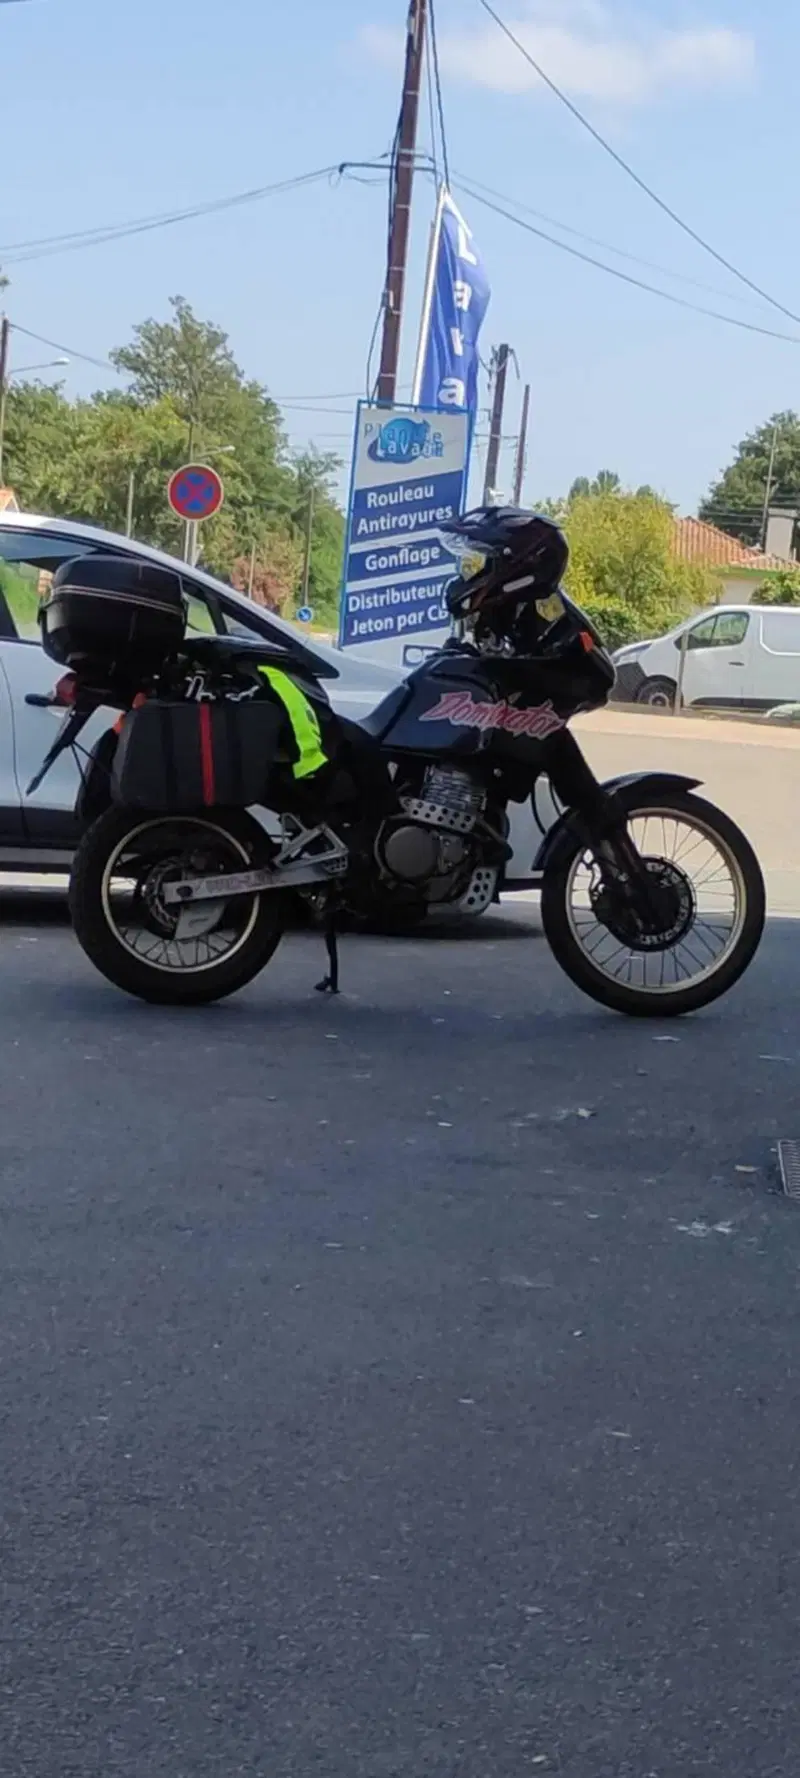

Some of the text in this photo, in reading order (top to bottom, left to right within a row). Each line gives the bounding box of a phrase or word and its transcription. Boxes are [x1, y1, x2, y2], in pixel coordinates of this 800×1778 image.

[366, 484, 434, 509] Rouleau
[357, 505, 453, 536] Antirayures
[365, 545, 440, 572] Gonflage
[348, 582, 443, 613] Distributeur
[350, 616, 394, 637] Jeton
[397, 610, 426, 632] par
[419, 691, 565, 740] Dominator
